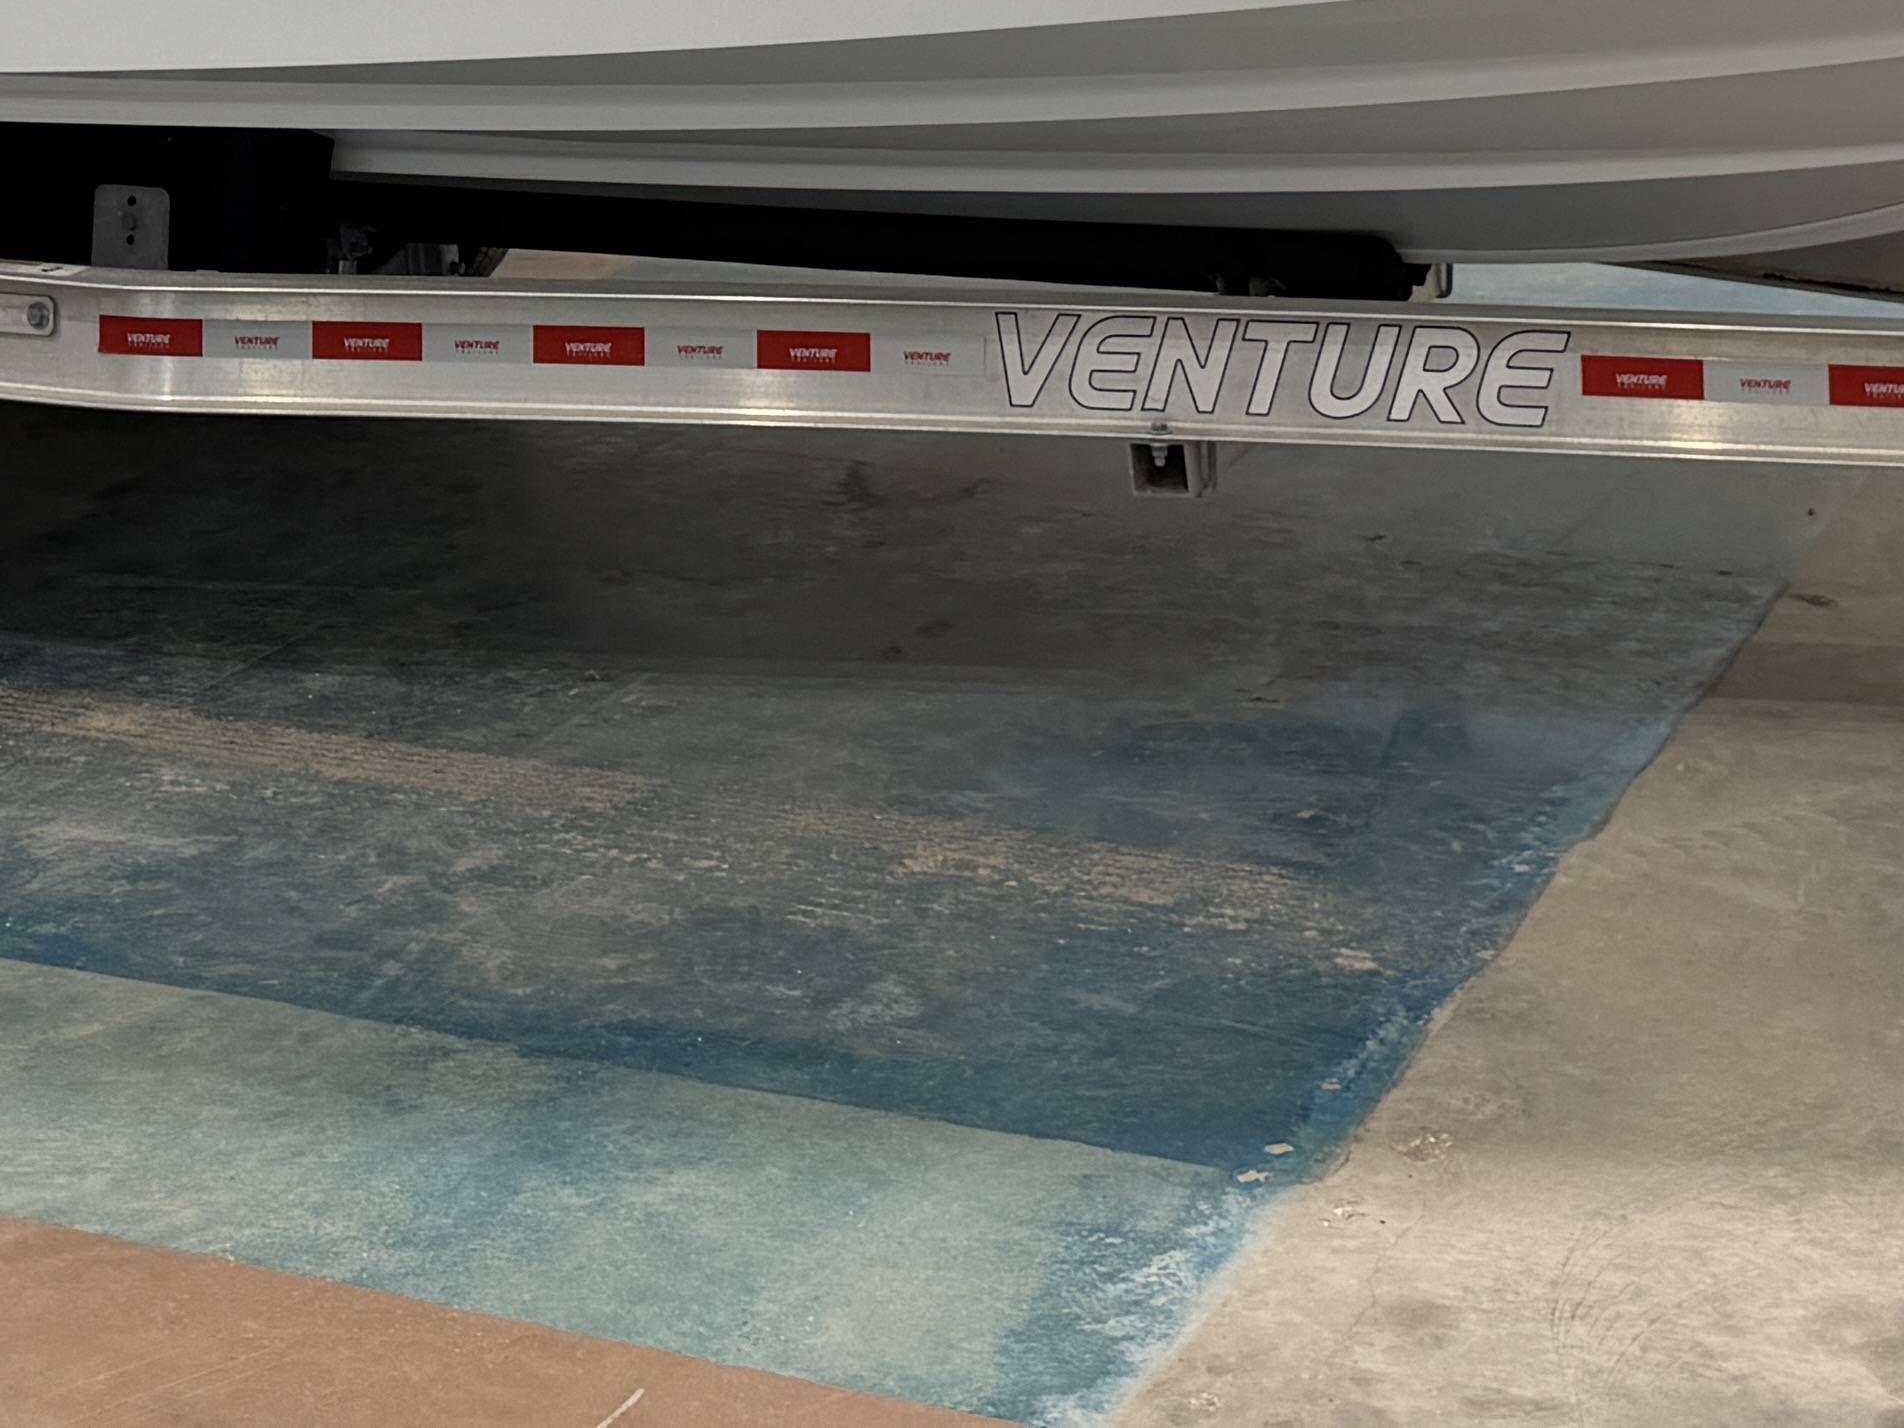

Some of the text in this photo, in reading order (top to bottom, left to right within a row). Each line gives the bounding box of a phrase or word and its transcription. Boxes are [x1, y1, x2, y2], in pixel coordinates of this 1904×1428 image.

[127, 333, 172, 344] VENTURE
[234, 335, 280, 346] VENTURE
[344, 338, 390, 349] VENTURE
[454, 340, 500, 350] VENTURE
[565, 342, 612, 353] VENTURE
[677, 345, 723, 356] VENTURE
[789, 348, 837, 359] VENTURE
[904, 351, 952, 362] VENTURE
[995, 311, 1572, 429] VENTURE
[1615, 373, 1668, 385] VENTURE
[1739, 378, 1791, 390] VENTURE
